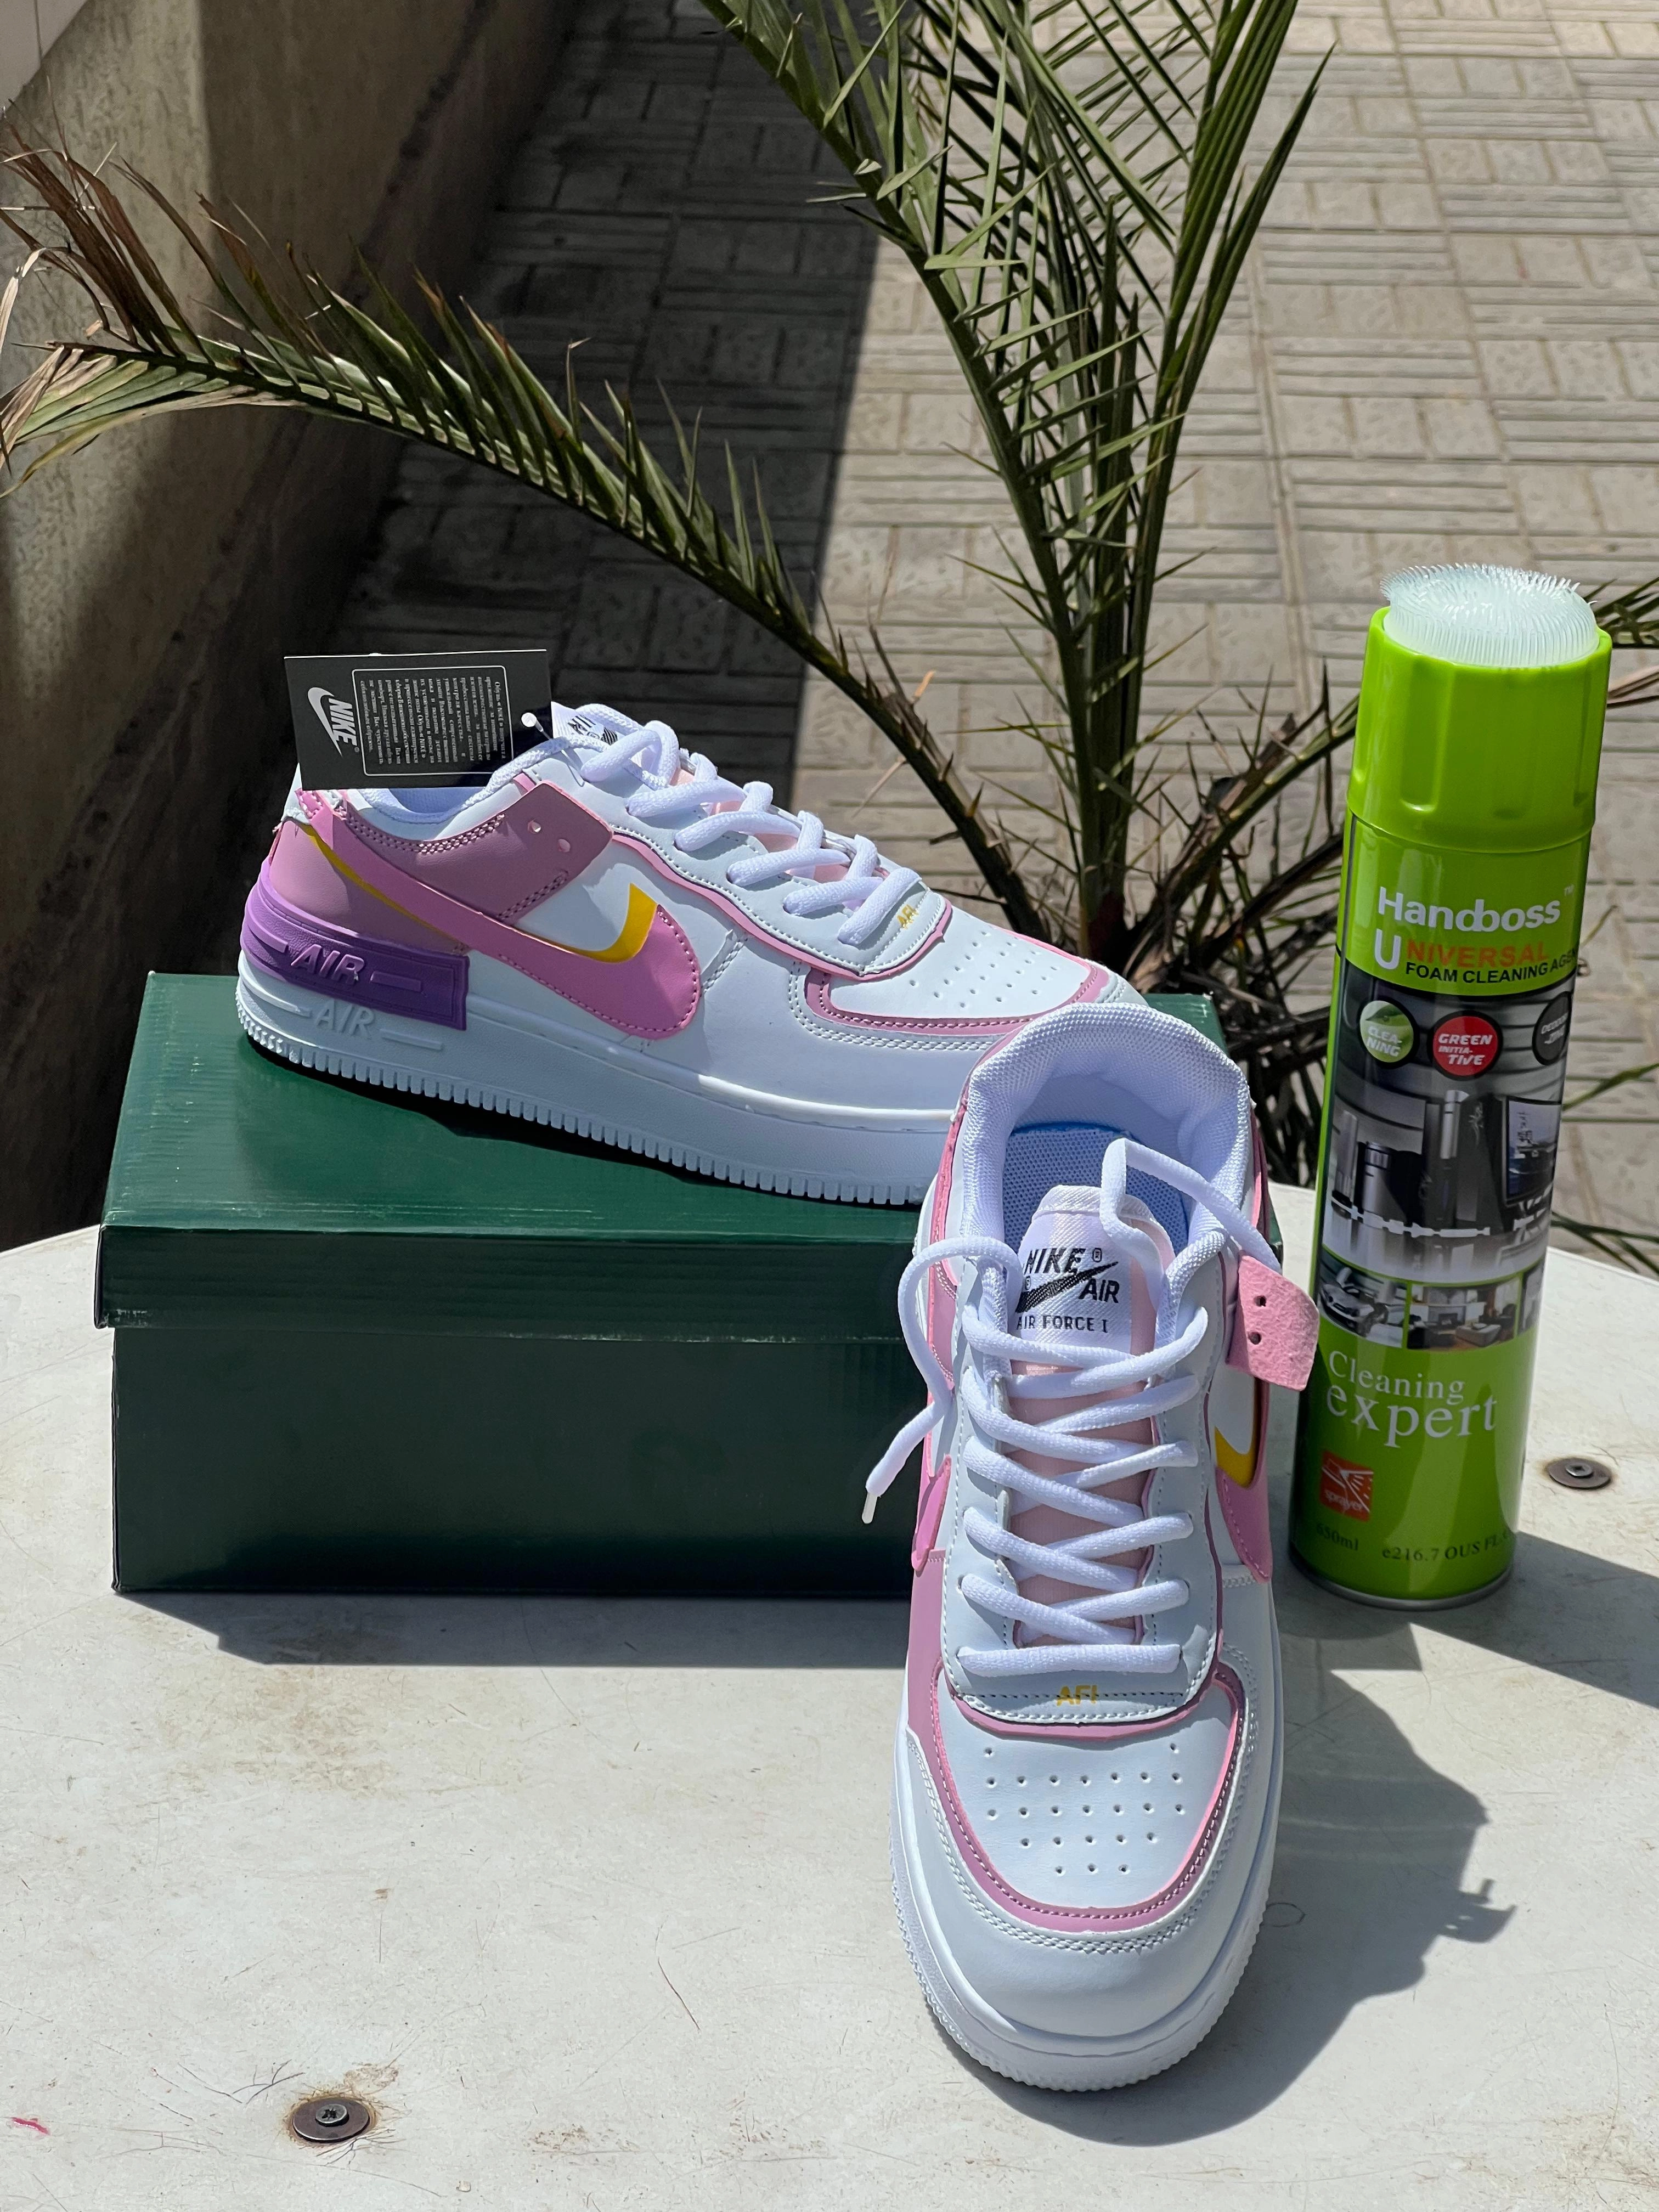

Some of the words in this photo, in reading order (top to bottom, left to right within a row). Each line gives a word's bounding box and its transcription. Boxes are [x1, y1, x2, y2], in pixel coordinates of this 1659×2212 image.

[329, 696, 358, 746] NIKE
[1378, 886, 1561, 933] Handboss
[291, 944, 365, 985] AIR
[1405, 961, 1458, 983] FOAM
[1462, 962, 1548, 984] CLEANING
[314, 998, 375, 1039] AIR
[1367, 1037, 1400, 1058] NING
[1438, 1033, 1493, 1046] GREEN
[1438, 1045, 1473, 1054] INITIA-
[1448, 1053, 1486, 1066] TIVE
[1024, 1248, 1086, 1274] NIKE
[1078, 1278, 1120, 1304] AIR
[1016, 1315, 1036, 1330] AIR
[1042, 1315, 1095, 1331] FORCE
[1328, 1350, 1465, 1406] Cleaning
[1326, 1384, 1497, 1449] expert
[1444, 1540, 1481, 1560] OUS
